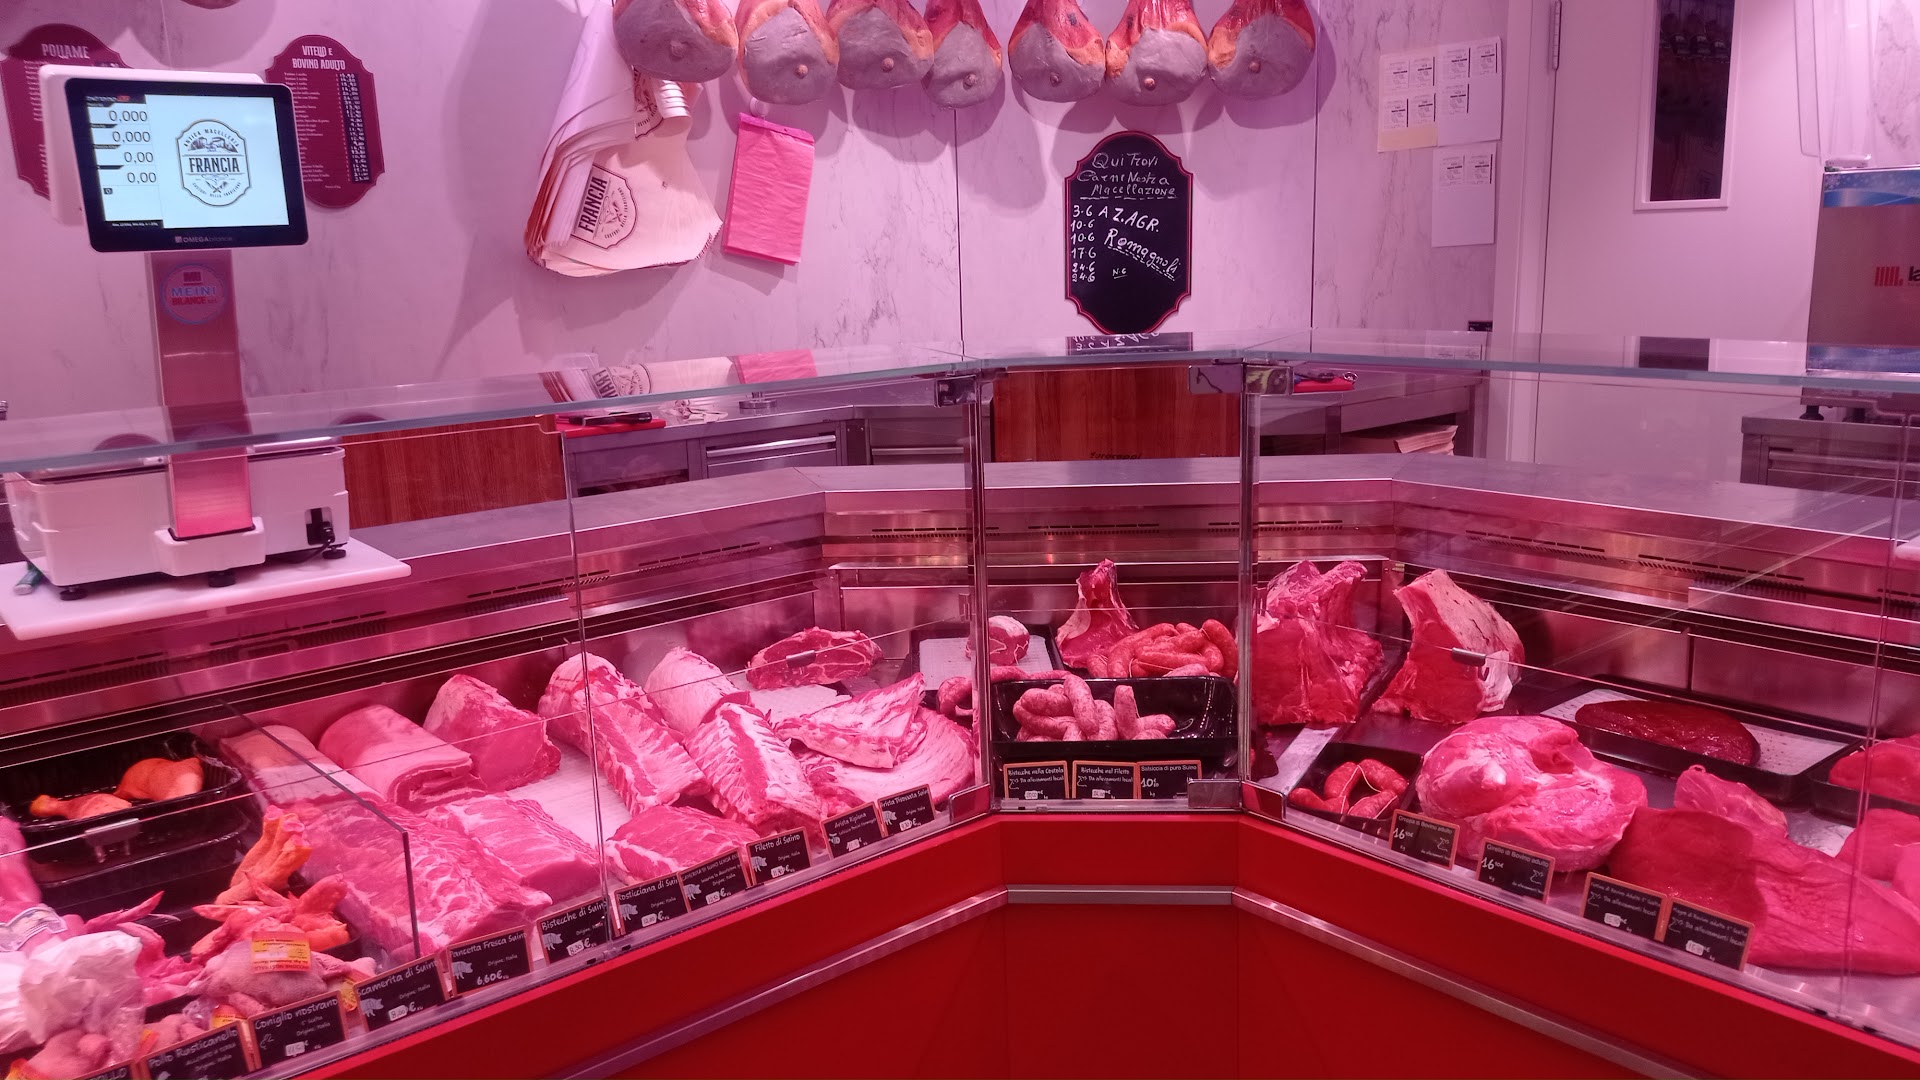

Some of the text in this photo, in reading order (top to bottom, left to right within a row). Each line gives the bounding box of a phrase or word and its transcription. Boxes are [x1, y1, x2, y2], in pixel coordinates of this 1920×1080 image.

[292, 58, 319, 69] BOVINO
[108, 110, 148, 123] 0,000
[112, 131, 151, 143] 0,000
[124, 151, 154, 164] 0,00
[1092, 152, 1124, 169] Qui
[188, 157, 240, 173] FRANCIA
[127, 172, 157, 184] 0,00
[578, 176, 608, 234] FRANCIA
[171, 286, 216, 297] MEINI
[1393, 827, 1405, 840] 16
[754, 842, 775, 853] Filetto
[775, 837, 783, 847] di
[1481, 856, 1495, 870] 16
[1511, 851, 1531, 862] Bovino
[657, 880, 664, 890] di
[541, 912, 578, 931] Bistecche
[578, 906, 587, 918] di
[482, 938, 507, 950] Fresca
[357, 974, 404, 998] Scamerita
[405, 967, 414, 979] di
[255, 1011, 293, 1030] Coniglio
[295, 998, 338, 1017] nostrano
[149, 1053, 174, 1068] Pollo
